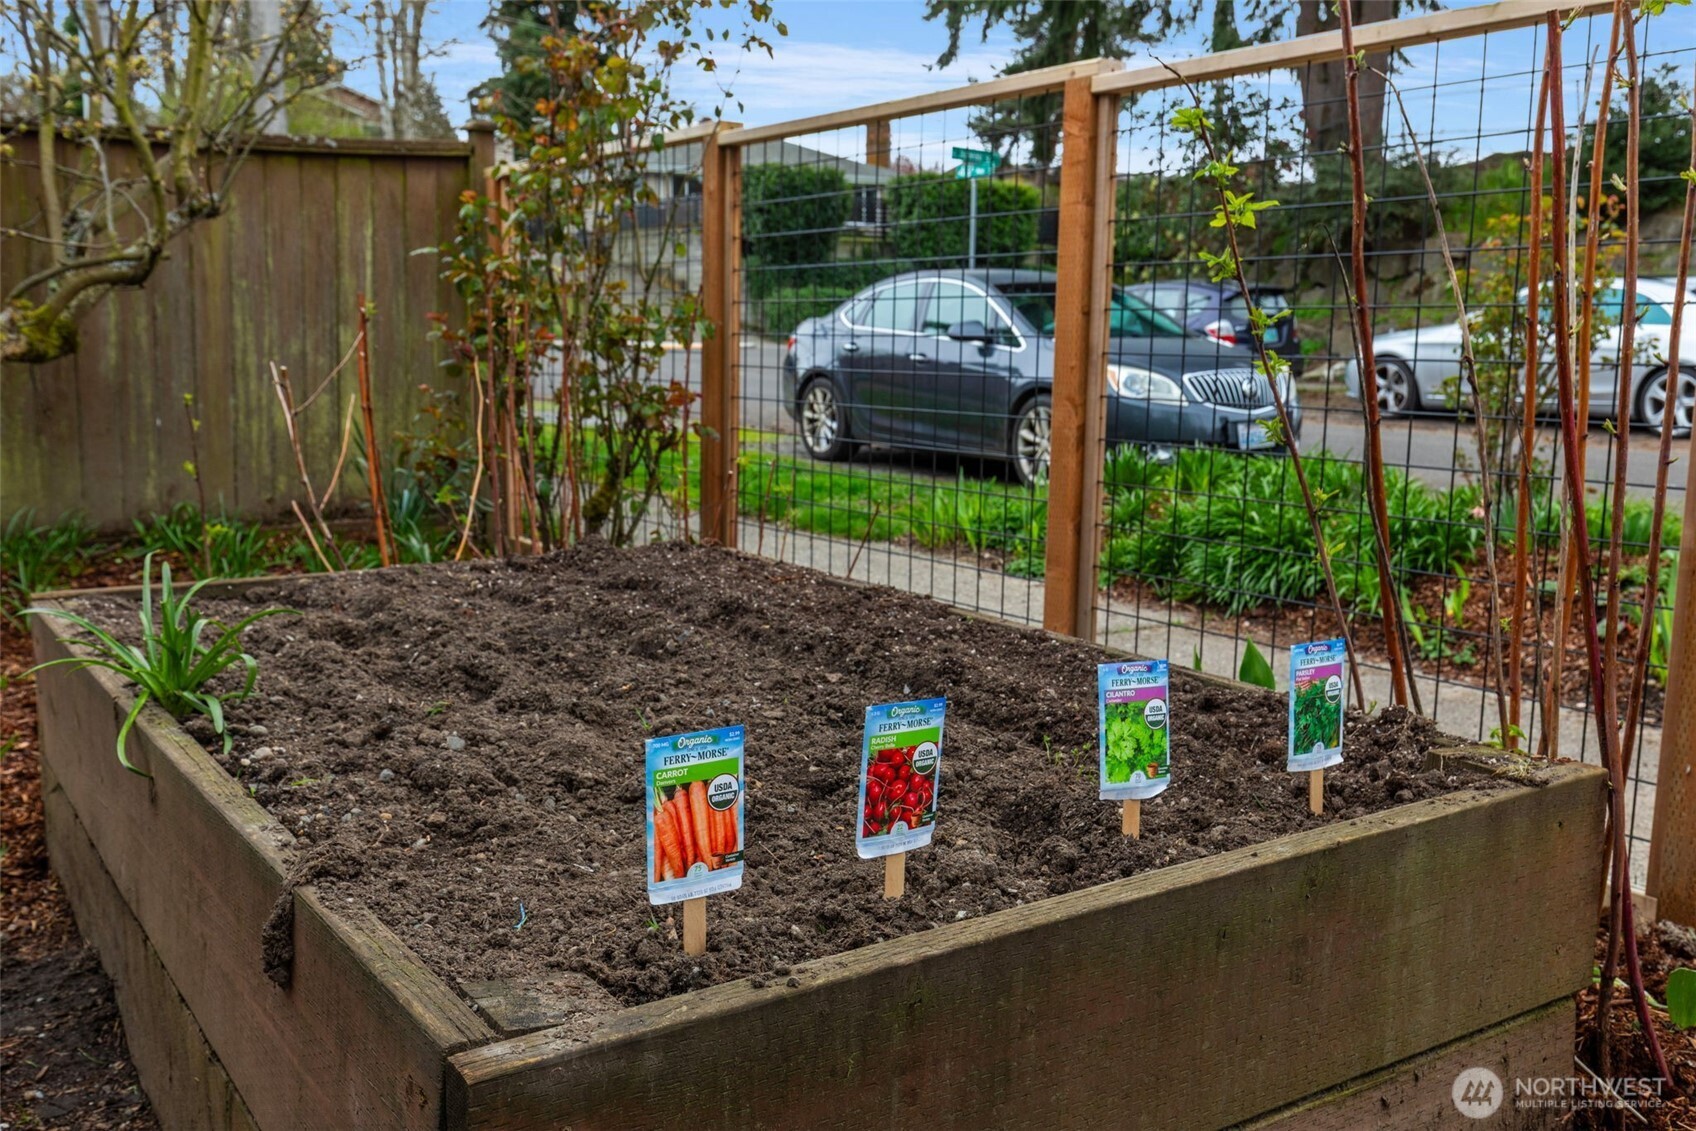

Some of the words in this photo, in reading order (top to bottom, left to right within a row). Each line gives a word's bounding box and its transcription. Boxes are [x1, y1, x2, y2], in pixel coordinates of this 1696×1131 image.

[1308, 644, 1328, 654] Organic
[1122, 664, 1148, 674] Organic
[1296, 668, 1316, 676] PARSLEY
[1106, 690, 1136, 698] CILANTRO
[891, 706, 920, 717] Organic
[678, 734, 712, 748] Organic
[872, 736, 896, 744] RADISH
[918, 748, 934, 758] USDA
[916, 758, 934, 768] ORGANIC
[656, 768, 688, 780] CARROT
[714, 782, 732, 792] USDA
[712, 792, 735, 802] ORGANIC
